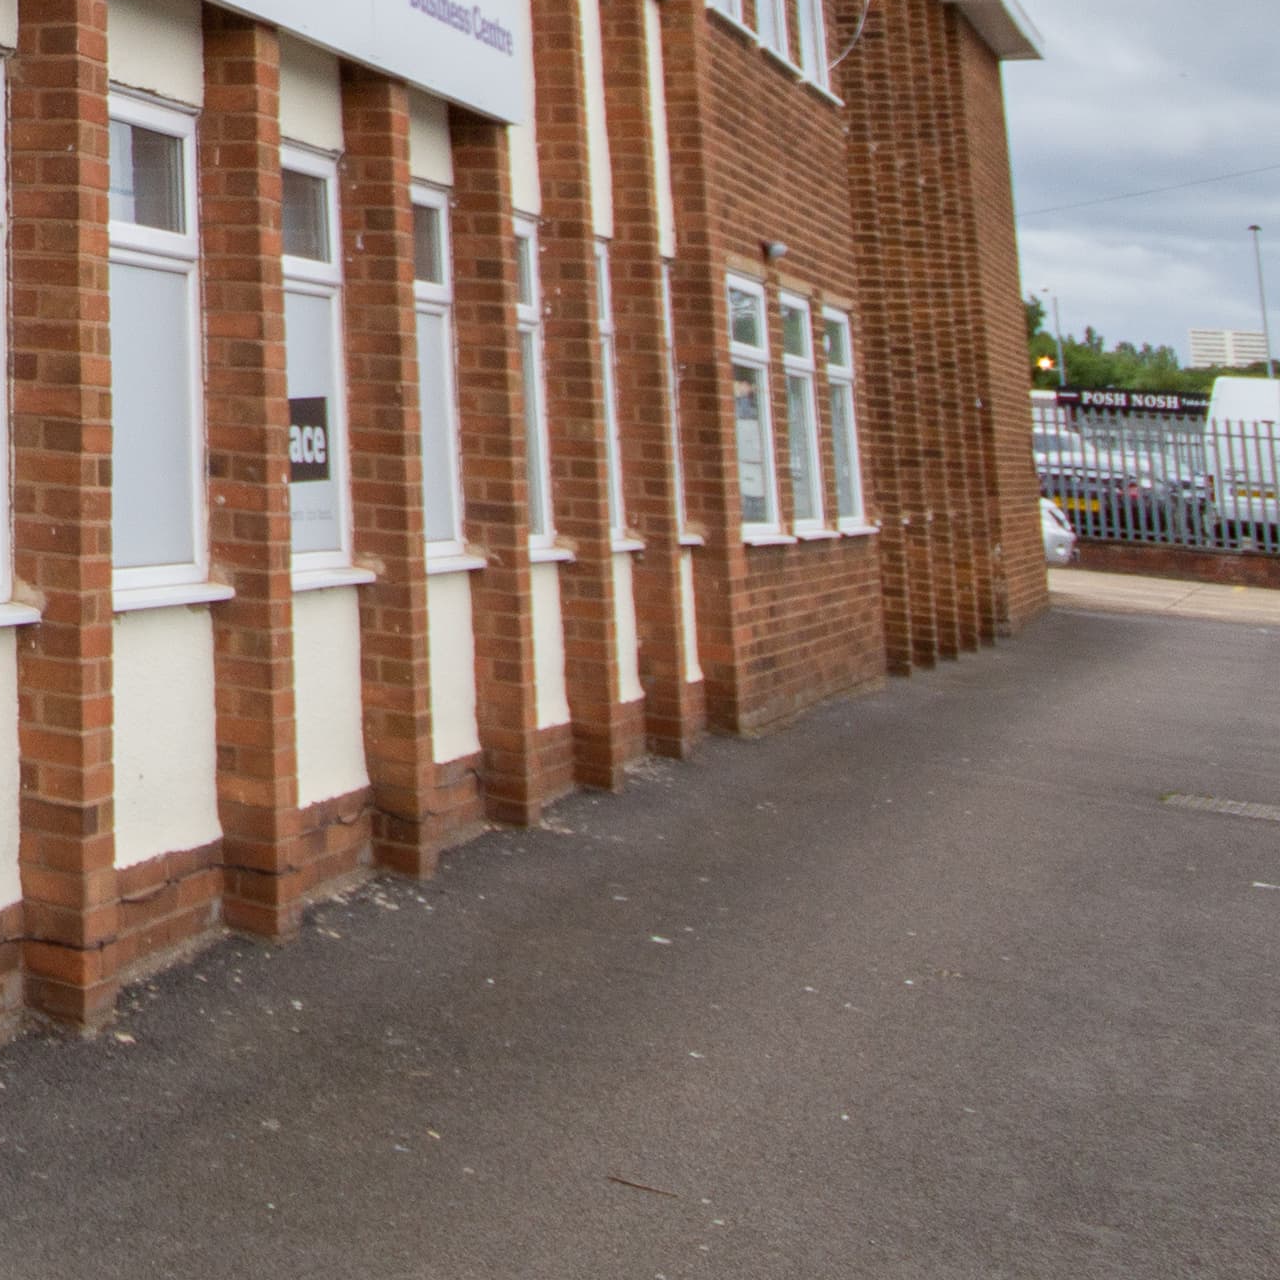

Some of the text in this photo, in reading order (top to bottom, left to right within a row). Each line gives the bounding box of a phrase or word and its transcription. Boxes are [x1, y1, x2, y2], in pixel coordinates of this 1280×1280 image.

[472, 4, 514, 57] Centre
[1081, 390, 1127, 406] POSH
[1131, 393, 1180, 409] NOSH
[289, 424, 327, 464] ace
